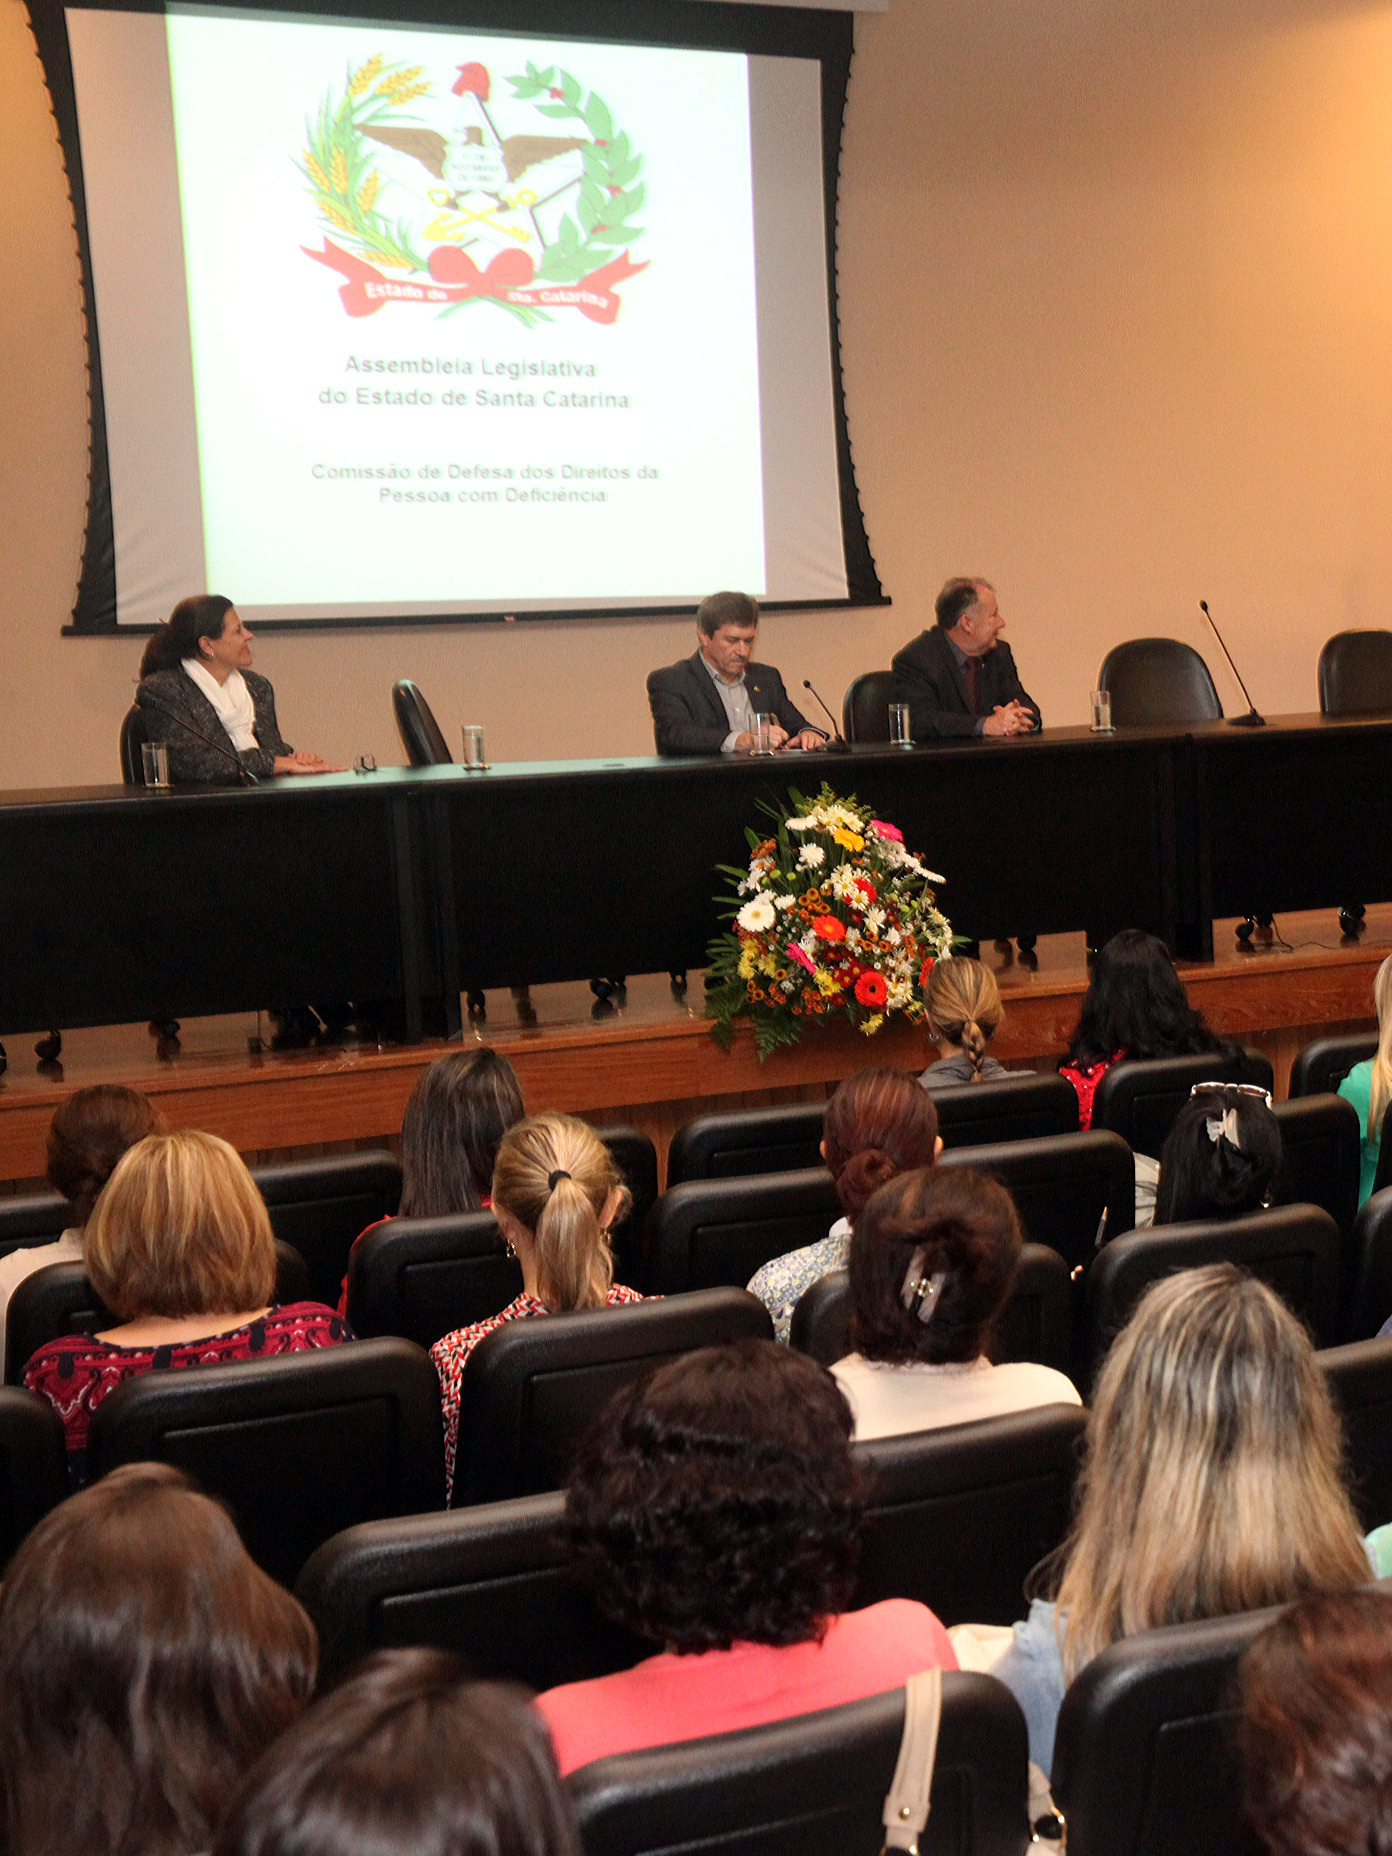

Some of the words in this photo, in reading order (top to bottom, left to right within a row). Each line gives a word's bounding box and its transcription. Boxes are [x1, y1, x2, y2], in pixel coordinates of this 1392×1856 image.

[345, 355, 474, 376] Assembleia
[481, 358, 597, 380] Legislativa
[318, 387, 347, 405] do
[355, 387, 433, 407] Estado
[441, 389, 468, 408] de
[475, 390, 536, 408] Santa
[543, 390, 631, 410] Catarina
[311, 463, 411, 481] Comissão
[417, 463, 441, 481] de
[447, 463, 513, 481] Defesa
[519, 464, 554, 481] dos
[561, 464, 630, 482] Direitos
[636, 464, 660, 482] da
[379, 486, 451, 504] Pessoa
[457, 490, 499, 504] com
[505, 484, 606, 504] Deficiência
